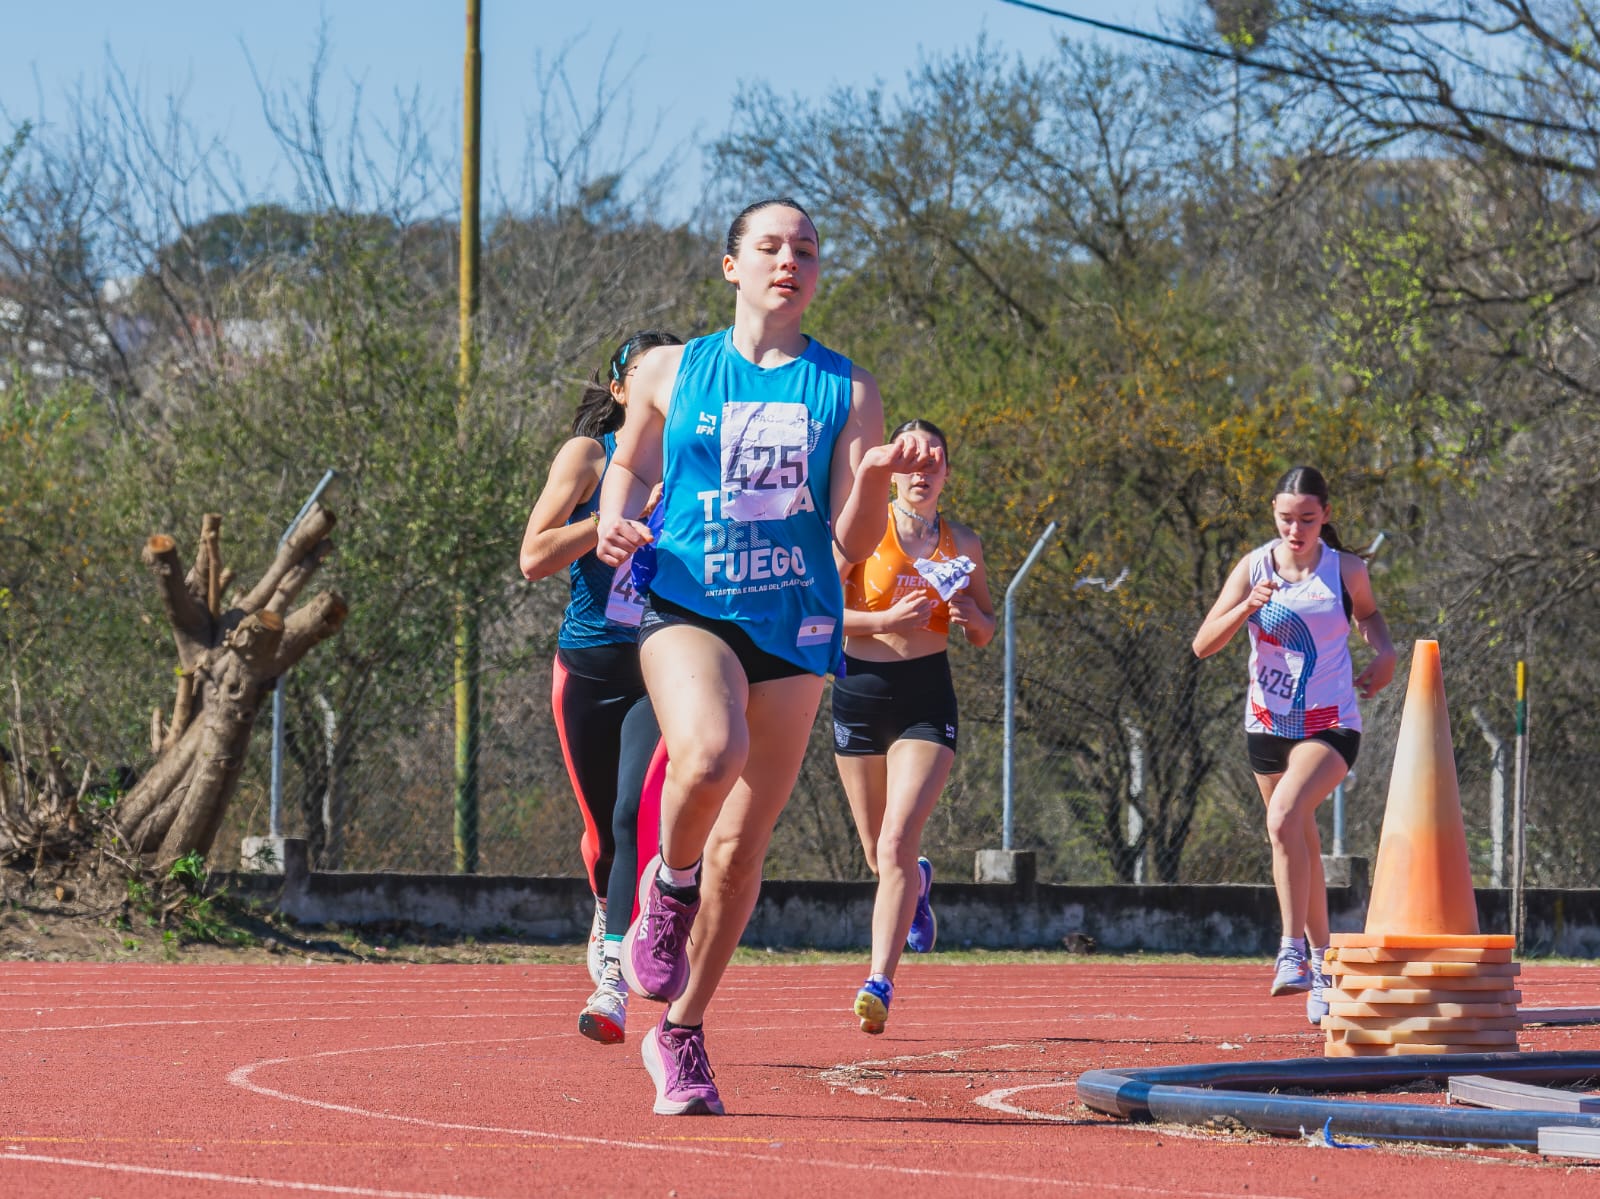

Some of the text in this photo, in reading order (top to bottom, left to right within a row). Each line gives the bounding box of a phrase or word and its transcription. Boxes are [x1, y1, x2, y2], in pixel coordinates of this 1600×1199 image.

[726, 446, 804, 490] 425
[704, 521, 771, 552] DEL
[704, 546, 806, 585] FUEGO
[1257, 666, 1296, 699] 429
